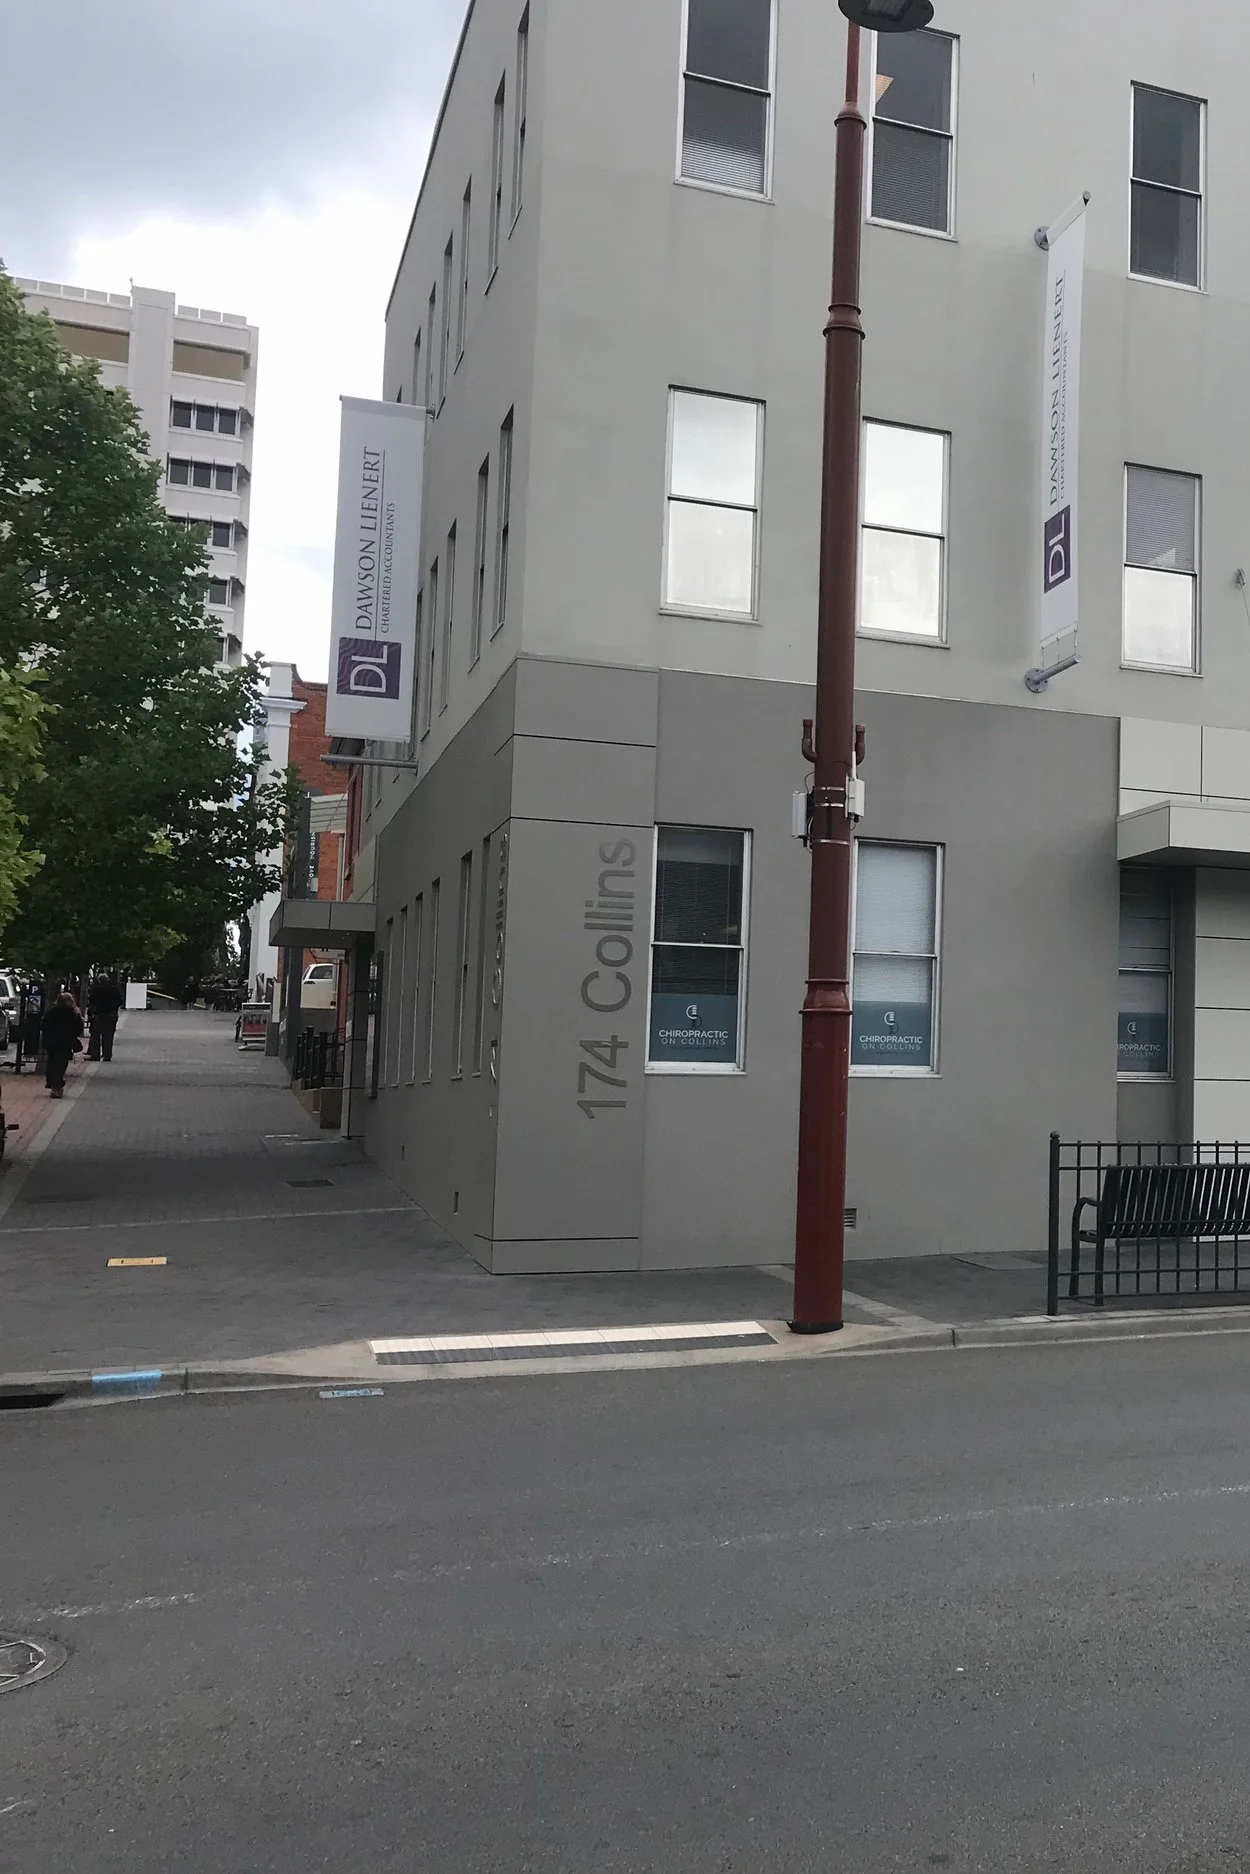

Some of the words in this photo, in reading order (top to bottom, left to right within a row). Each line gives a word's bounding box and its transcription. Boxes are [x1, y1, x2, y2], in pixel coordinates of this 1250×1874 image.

[1051, 276, 1065, 380] LIENERT
[1049, 390, 1061, 505] DAWSON
[1059, 425, 1067, 500] CHARTERED
[361, 446, 382, 534] LIENERT
[383, 502, 396, 574] ACCOUNTANTS
[1048, 513, 1066, 584] DL
[355, 540, 377, 631] DAWSON
[380, 576, 392, 634] CHARTERED
[349, 644, 388, 694] DL
[581, 837, 637, 1013] Collins
[659, 1029, 728, 1040] CHIROPRACTIC
[681, 1038, 726, 1046] COLLINS
[859, 1035, 923, 1045] CHIROPRACTIC
[861, 1042, 876, 1050] ON
[880, 1043, 921, 1051] COLLINS
[577, 1034, 629, 1120] 174
